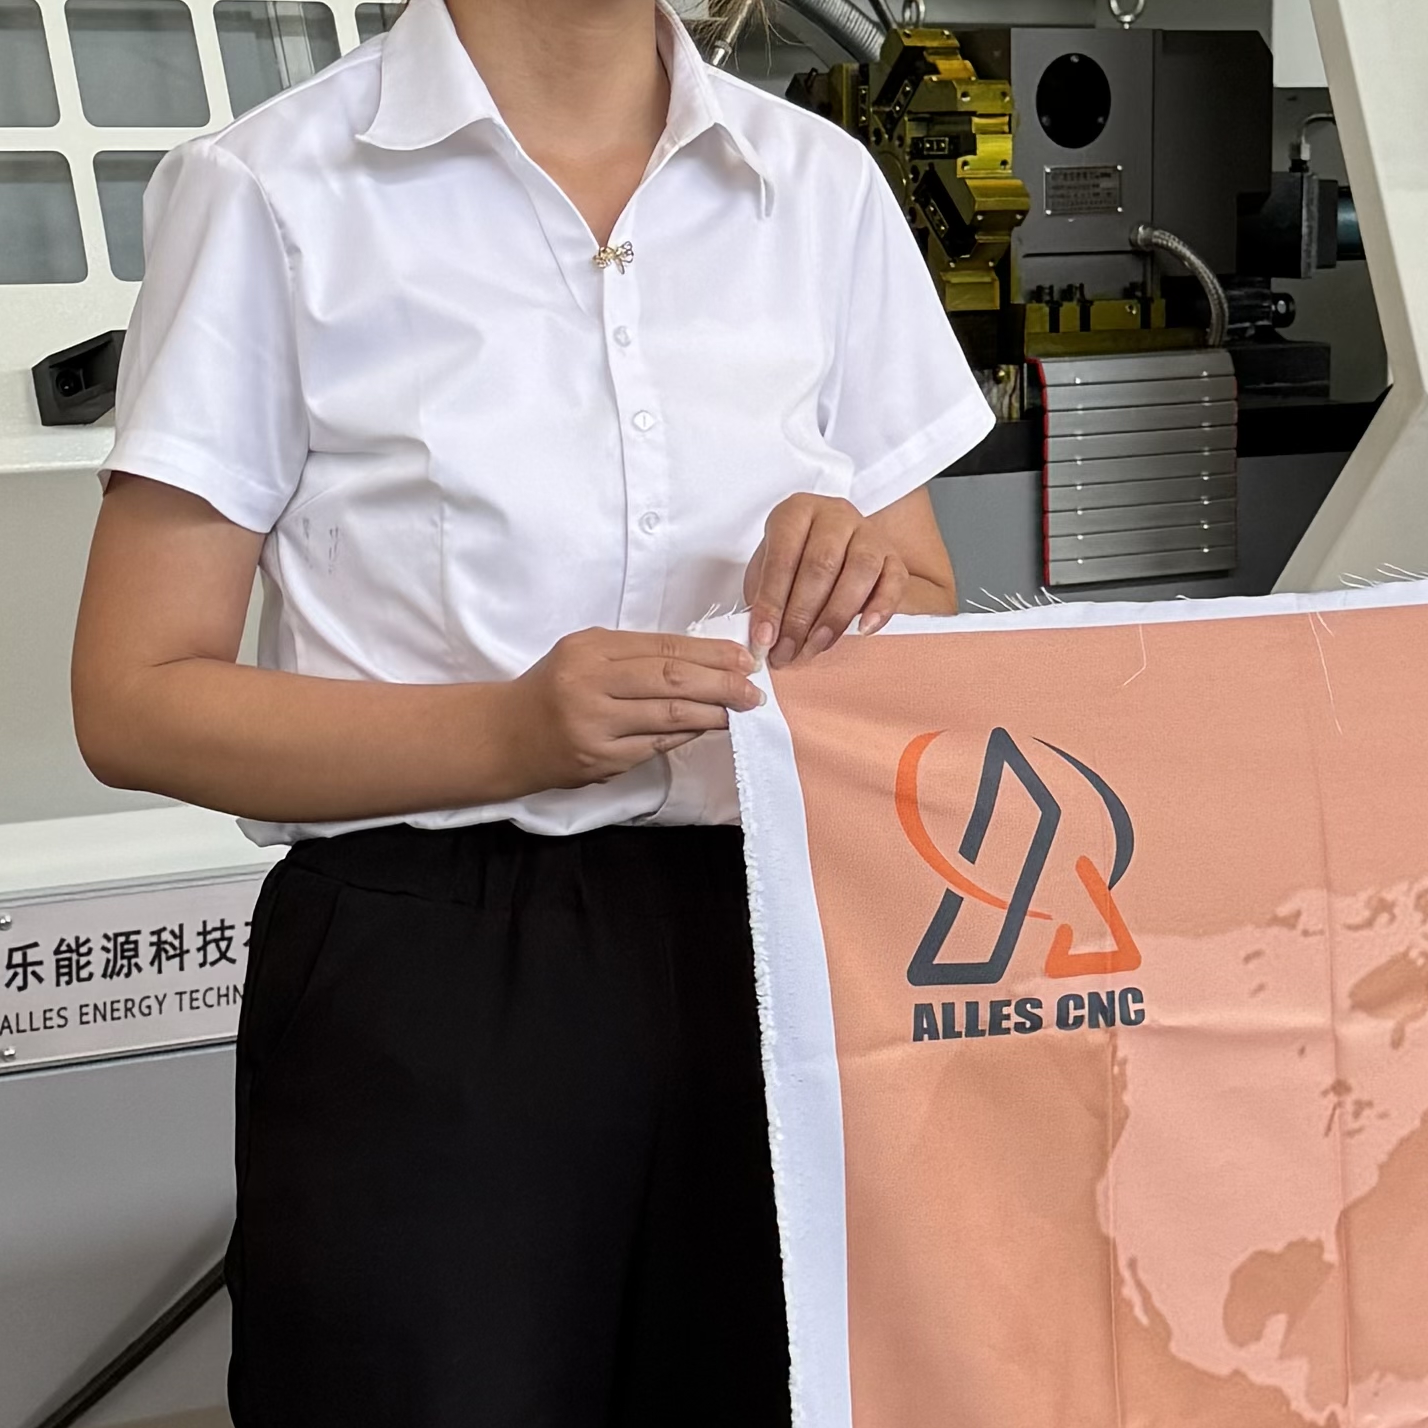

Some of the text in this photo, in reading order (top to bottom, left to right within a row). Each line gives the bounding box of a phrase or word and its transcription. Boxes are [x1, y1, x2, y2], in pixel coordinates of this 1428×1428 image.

[78, 992, 166, 1026] ENERGY
[174, 984, 246, 1012] TECHN
[912, 986, 1147, 1042] ALLES CNC
